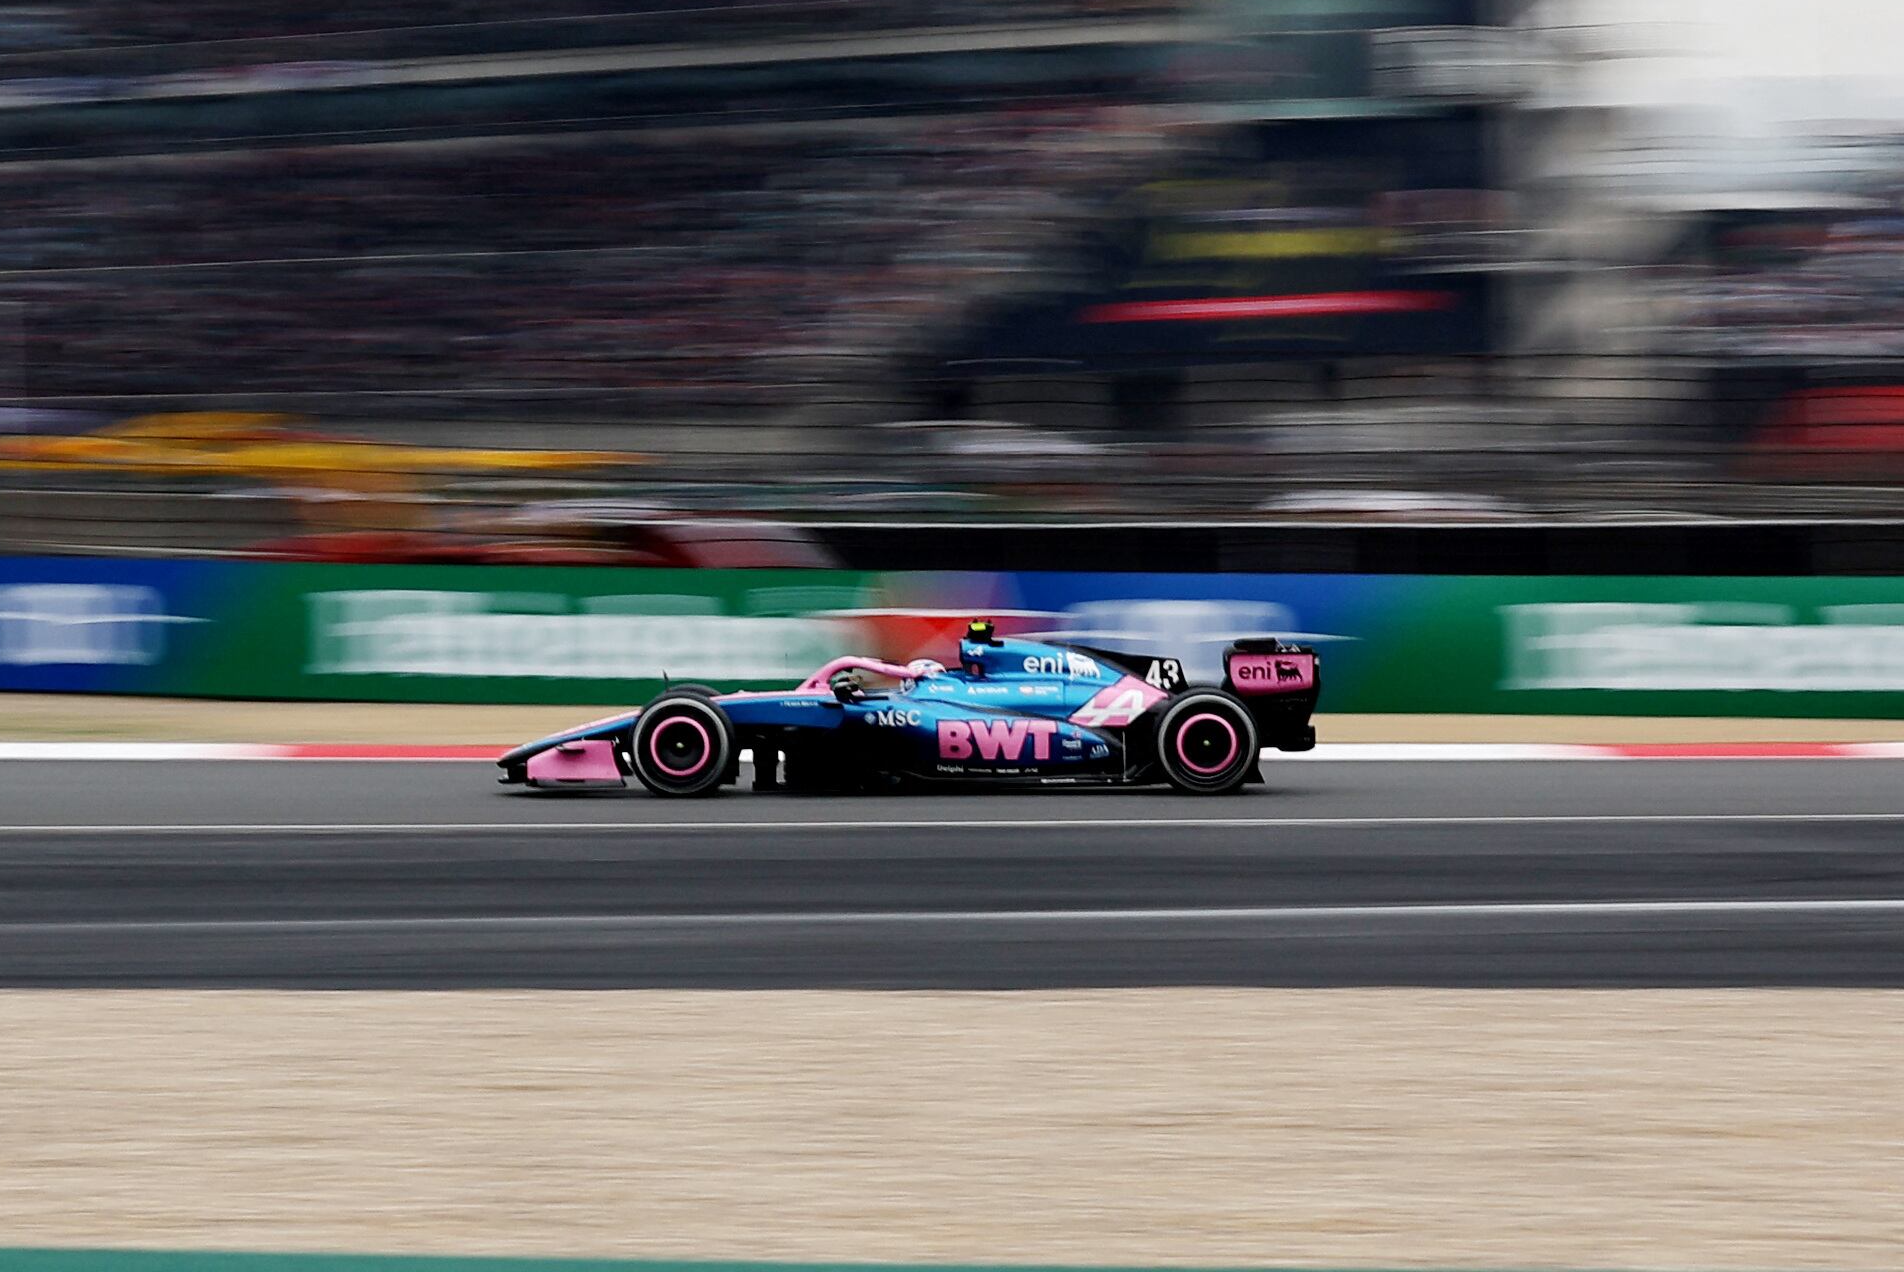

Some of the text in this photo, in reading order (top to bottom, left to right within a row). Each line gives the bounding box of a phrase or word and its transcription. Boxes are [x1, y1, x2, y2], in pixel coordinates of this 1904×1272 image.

[1023, 652, 1064, 674] eni
[1238, 661, 1271, 680] eni
[1146, 659, 1180, 690] 43
[876, 709, 921, 727] MSC
[937, 719, 1058, 760] BWT
